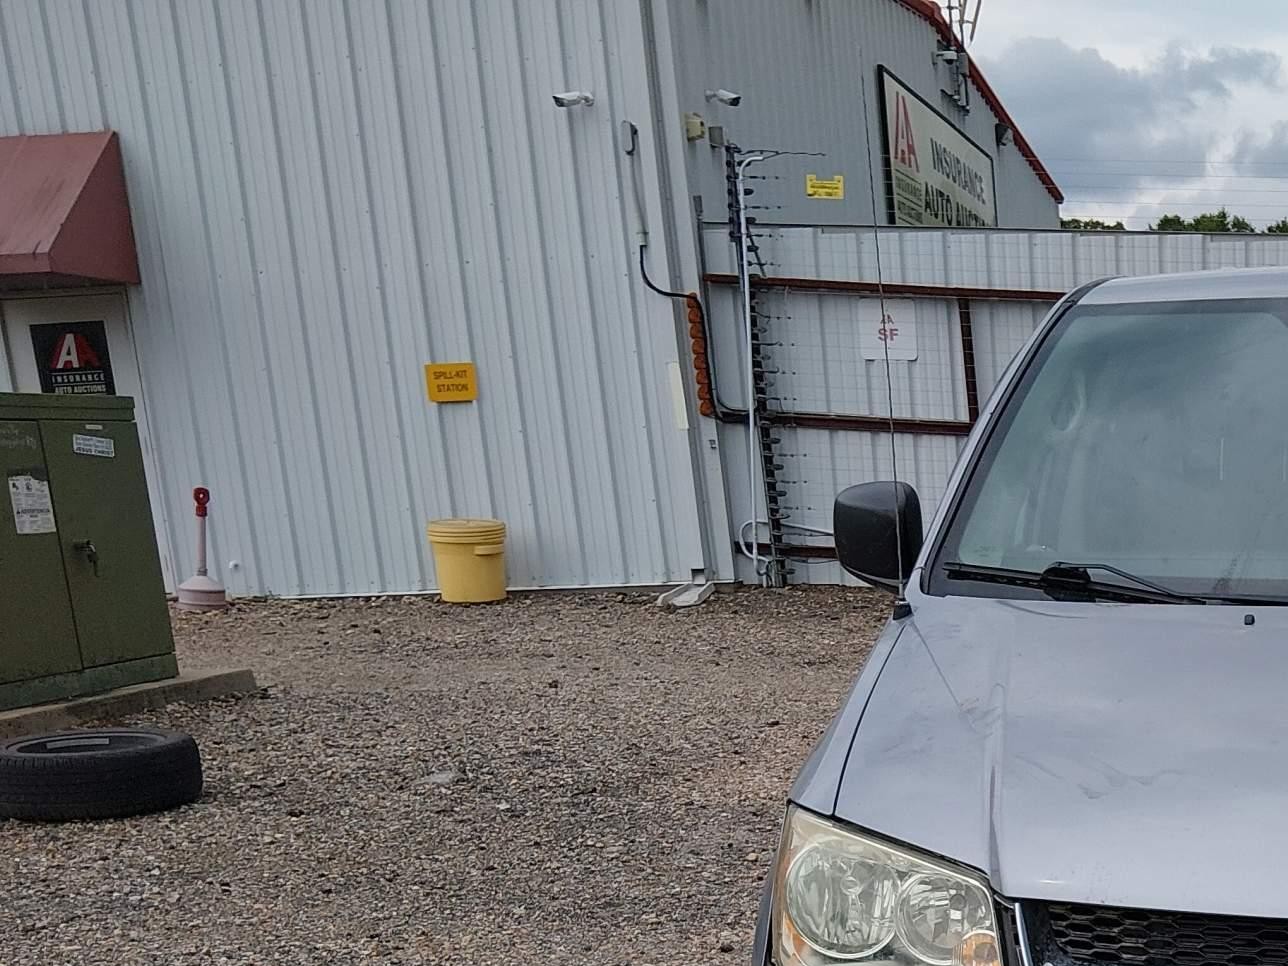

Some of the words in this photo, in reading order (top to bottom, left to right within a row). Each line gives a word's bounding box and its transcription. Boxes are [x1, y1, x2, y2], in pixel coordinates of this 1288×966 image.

[930, 138, 986, 205] INSURANCE
[924, 181, 953, 226] AUTO
[877, 328, 899, 342] SF
[51, 373, 105, 384] INSURANCE
[55, 386, 73, 395] AUTO
[74, 384, 107, 394] AUCTIONS
[436, 383, 469, 393] STATION
